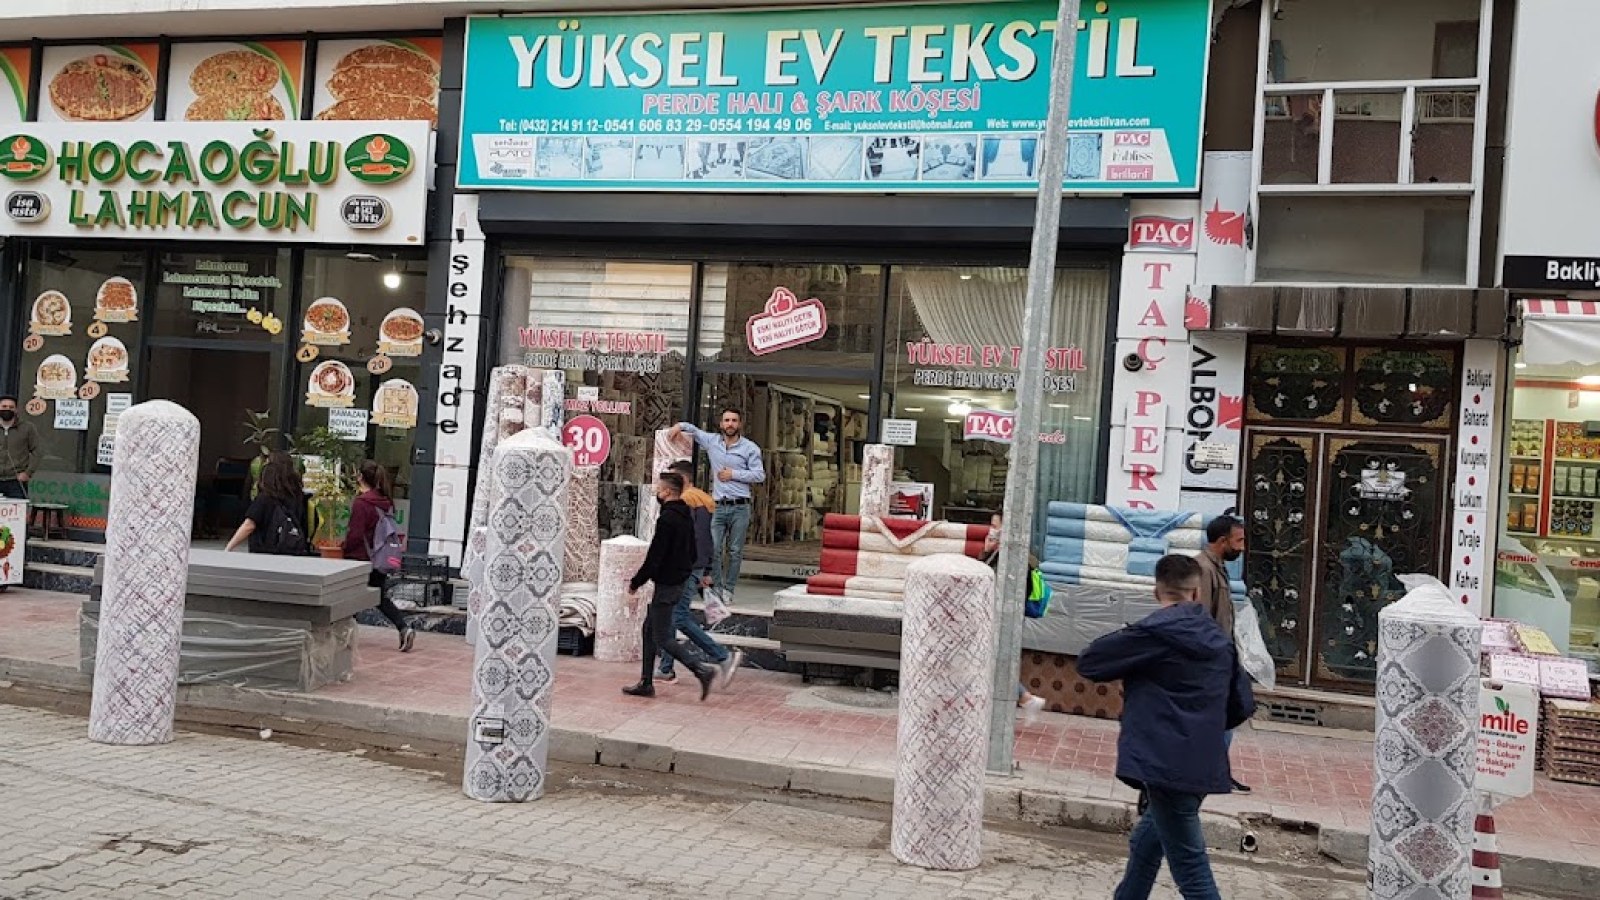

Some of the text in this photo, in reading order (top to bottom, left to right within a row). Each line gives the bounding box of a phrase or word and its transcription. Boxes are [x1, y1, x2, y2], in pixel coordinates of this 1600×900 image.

[508, 19, 739, 90] YÜKSEL
[763, 28, 843, 86] EV
[642, 83, 981, 119] PERDE HALI & ŞARK KÖŞESİ
[499, 119, 517, 131] Tel:
[520, 119, 549, 133] (0432)
[551, 119, 570, 131] 214
[571, 119, 583, 131] 91
[586, 119, 634, 131] 12-0541
[639, 119, 662, 131] 606
[666, 118, 681, 131] 83
[686, 118, 742, 131] 29-0554
[746, 118, 770, 131] 194
[774, 118, 791, 131] 49
[795, 118, 811, 131] 06
[987, 119, 1008, 128] Web:
[1012, 117, 1149, 129] www.yevtekstilvan.com
[1115, 133, 1149, 146] TAÇ
[57, 128, 341, 186] HOCAOĞLU
[68, 190, 319, 231] LAHMACUN
[1134, 222, 1190, 247] TAÇ
[1137, 262, 1172, 371] TAÇ
[92, 326, 99, 334] 4
[26, 338, 38, 349] 20
[439, 252, 470, 434] şehzade
[906, 337, 1087, 371] YÜKSEL EV TSTİL
[914, 369, 954, 387] PERDE
[1043, 371, 1077, 396] ÖŞESİ
[1466, 368, 1492, 391] Bakliyat
[82, 386, 94, 397] 20
[30, 401, 42, 412] 20
[1463, 408, 1489, 426] Baharat
[567, 425, 604, 453] 30
[967, 415, 1012, 440] TAÇ
[1460, 447, 1488, 469] Kuruyemiş
[1459, 489, 1482, 508] Lokum
[1458, 529, 1480, 552] Draje
[1455, 569, 1479, 590] Kahve
[1479, 711, 1530, 735] mile
